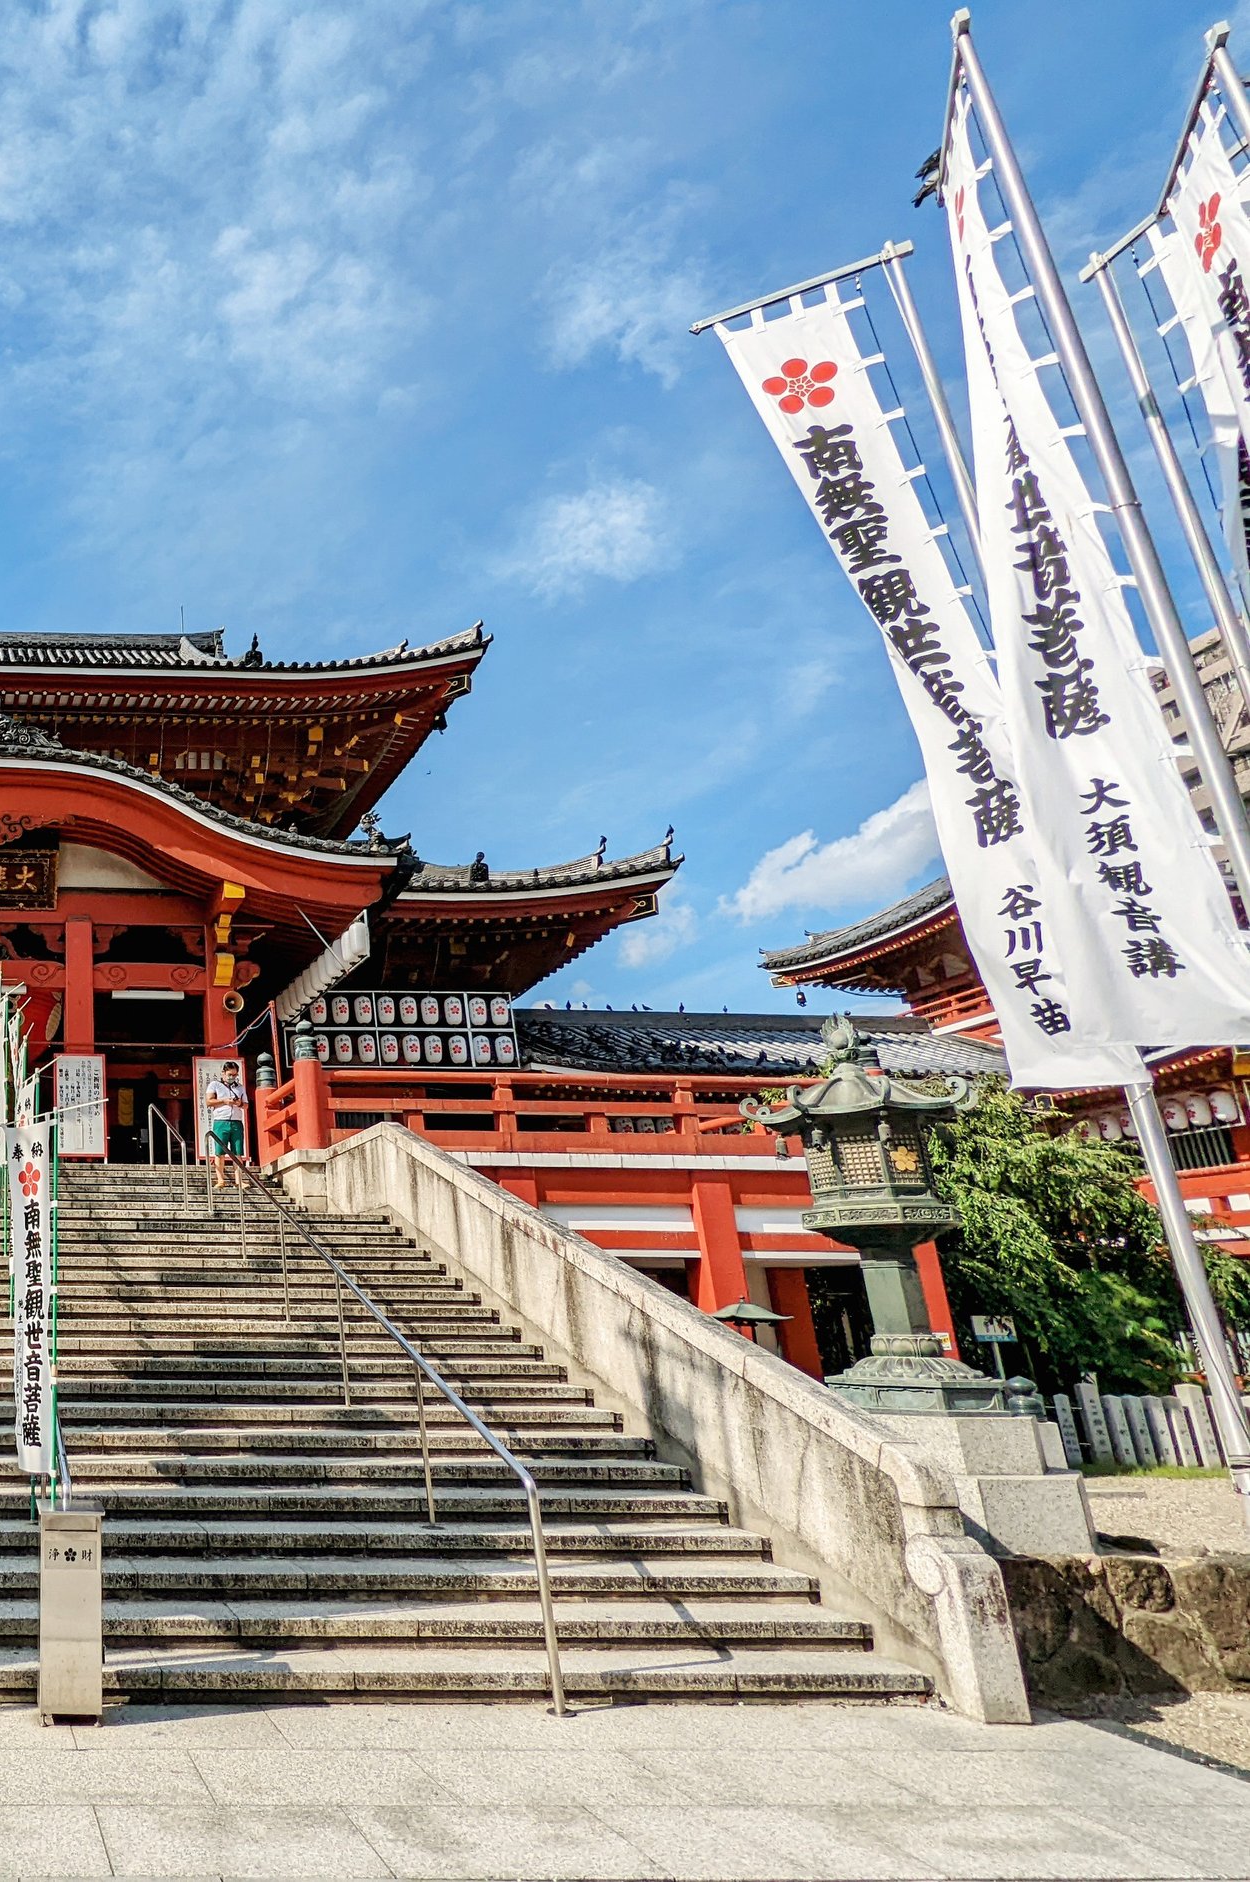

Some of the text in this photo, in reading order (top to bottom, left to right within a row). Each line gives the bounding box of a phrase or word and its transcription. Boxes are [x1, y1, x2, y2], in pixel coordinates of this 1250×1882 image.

[793, 424, 1023, 848] 南無聖観世音菩薩
[997, 884, 1072, 1036] 谷川早苗
[1079, 777, 1186, 979] 大須観音講
[12, 1141, 44, 1162] 奉納
[22, 1198, 45, 1448] 南無聖観世音菩薩
